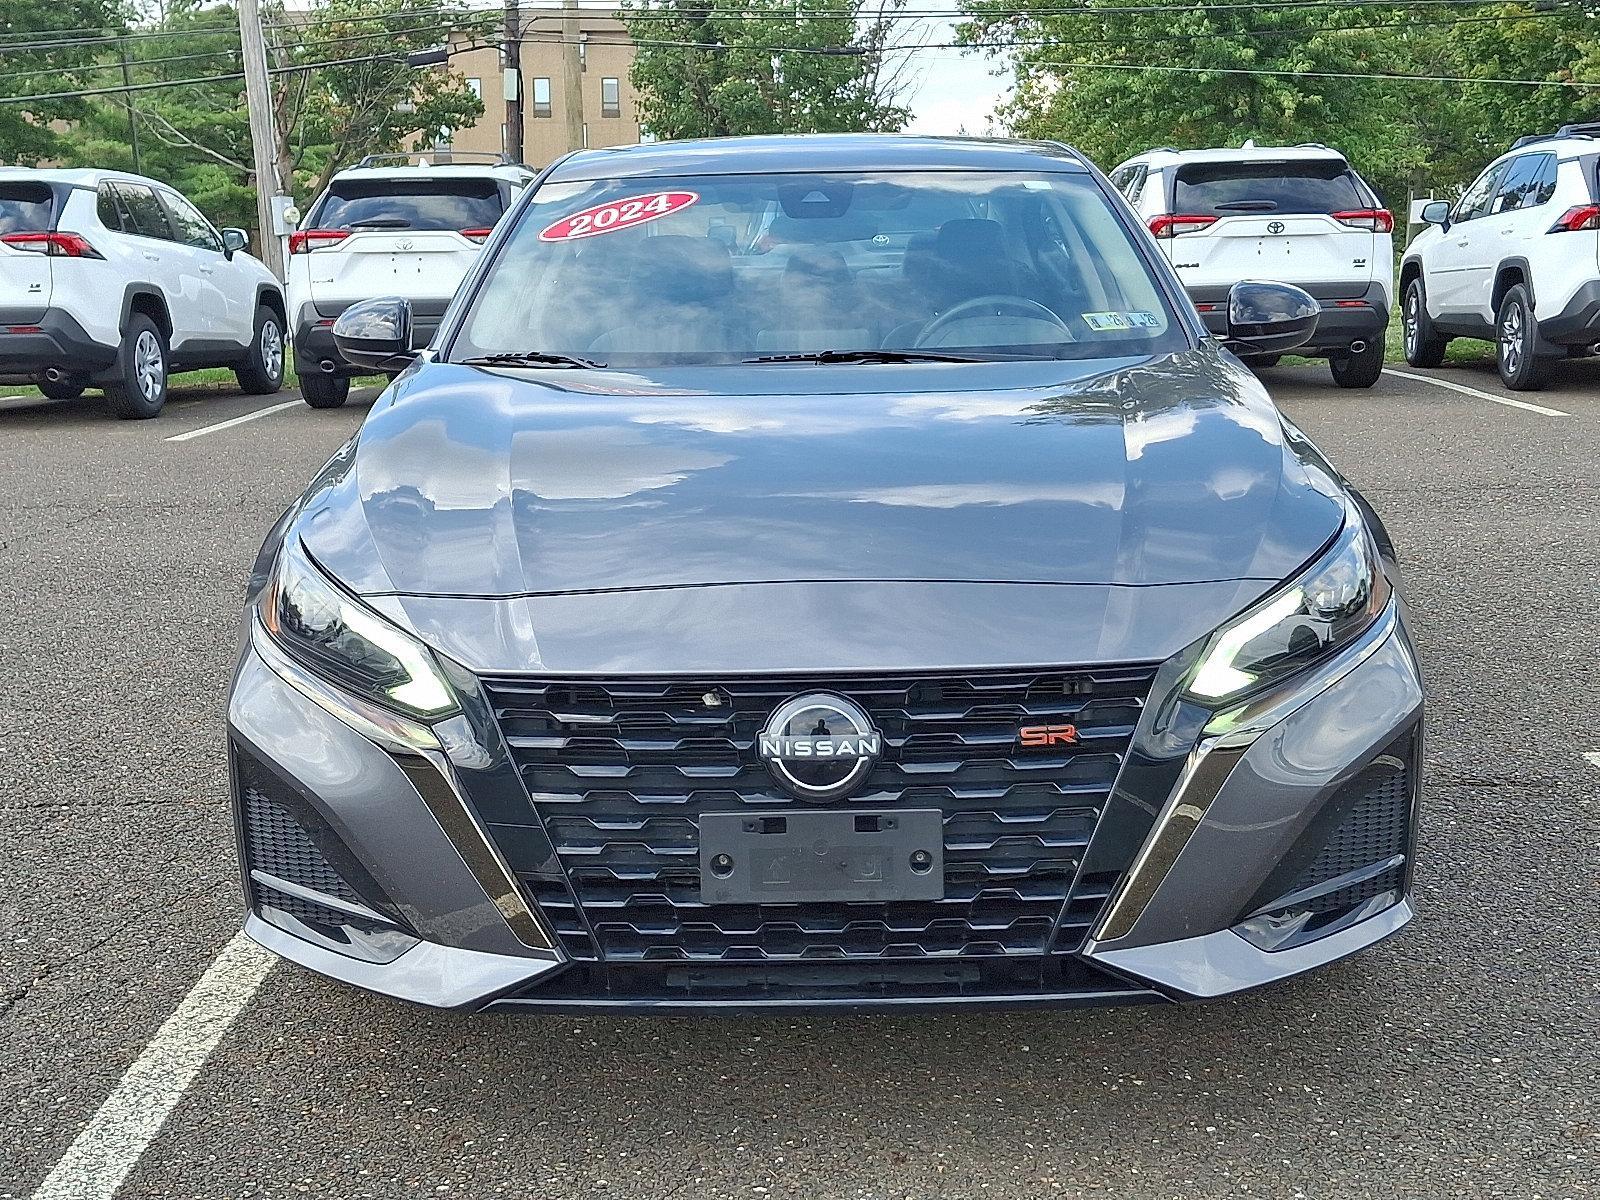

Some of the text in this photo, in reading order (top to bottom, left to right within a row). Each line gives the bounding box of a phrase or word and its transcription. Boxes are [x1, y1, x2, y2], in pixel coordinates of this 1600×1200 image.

[567, 194, 672, 237] 2024
[1020, 724, 1077, 745] SR
[762, 738, 878, 757] NISSAN
